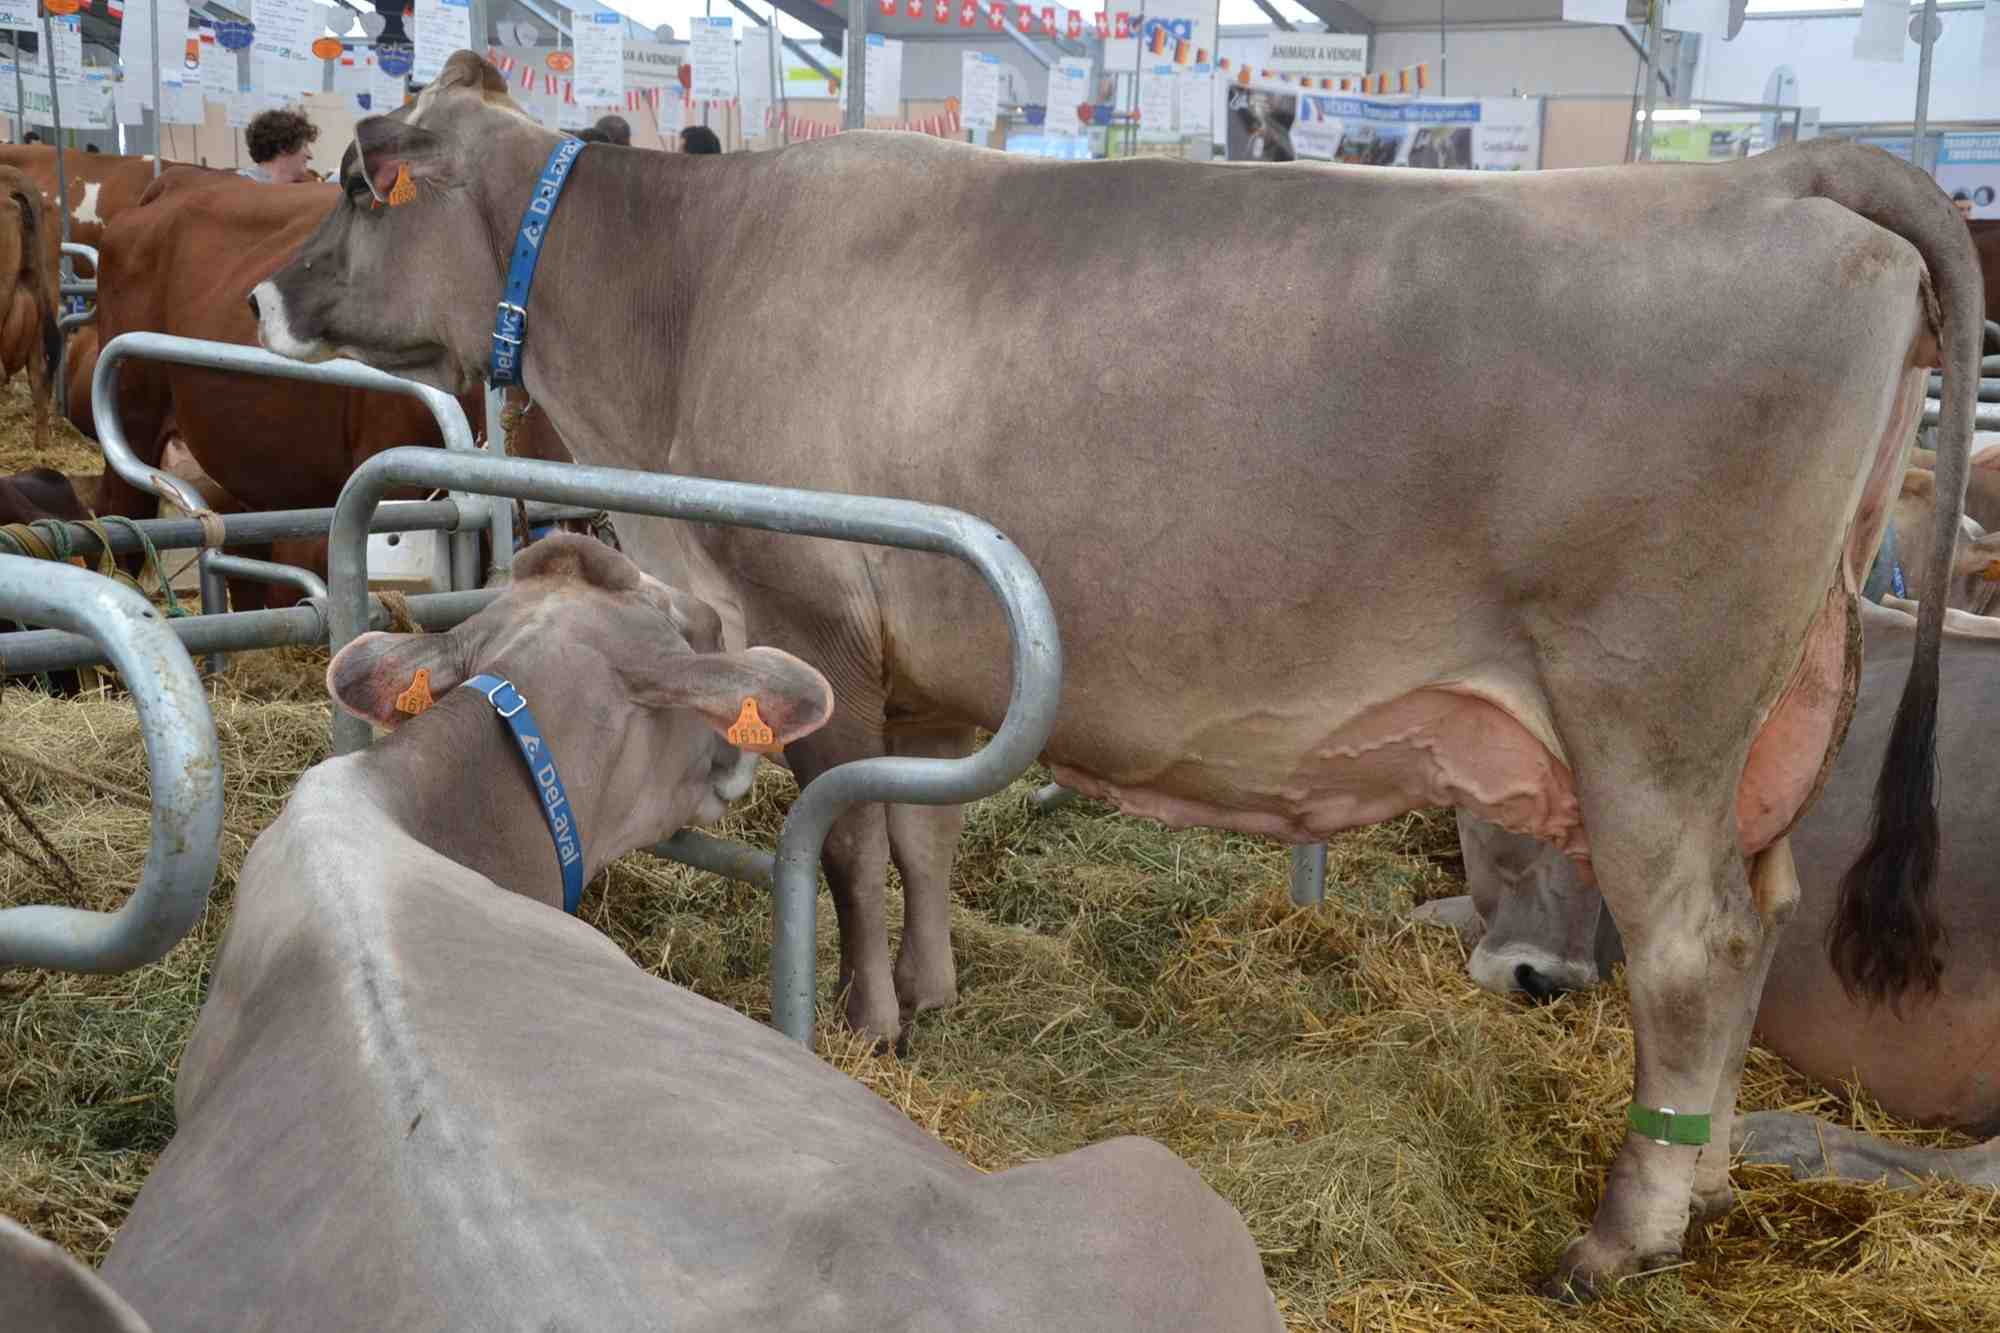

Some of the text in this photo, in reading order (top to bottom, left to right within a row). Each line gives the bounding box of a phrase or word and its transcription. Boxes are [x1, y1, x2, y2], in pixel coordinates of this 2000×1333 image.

[1272, 45, 1317, 60] ANIMAUX
[1326, 47, 1362, 62] VENDRE
[538, 763, 579, 866] DeLaval
